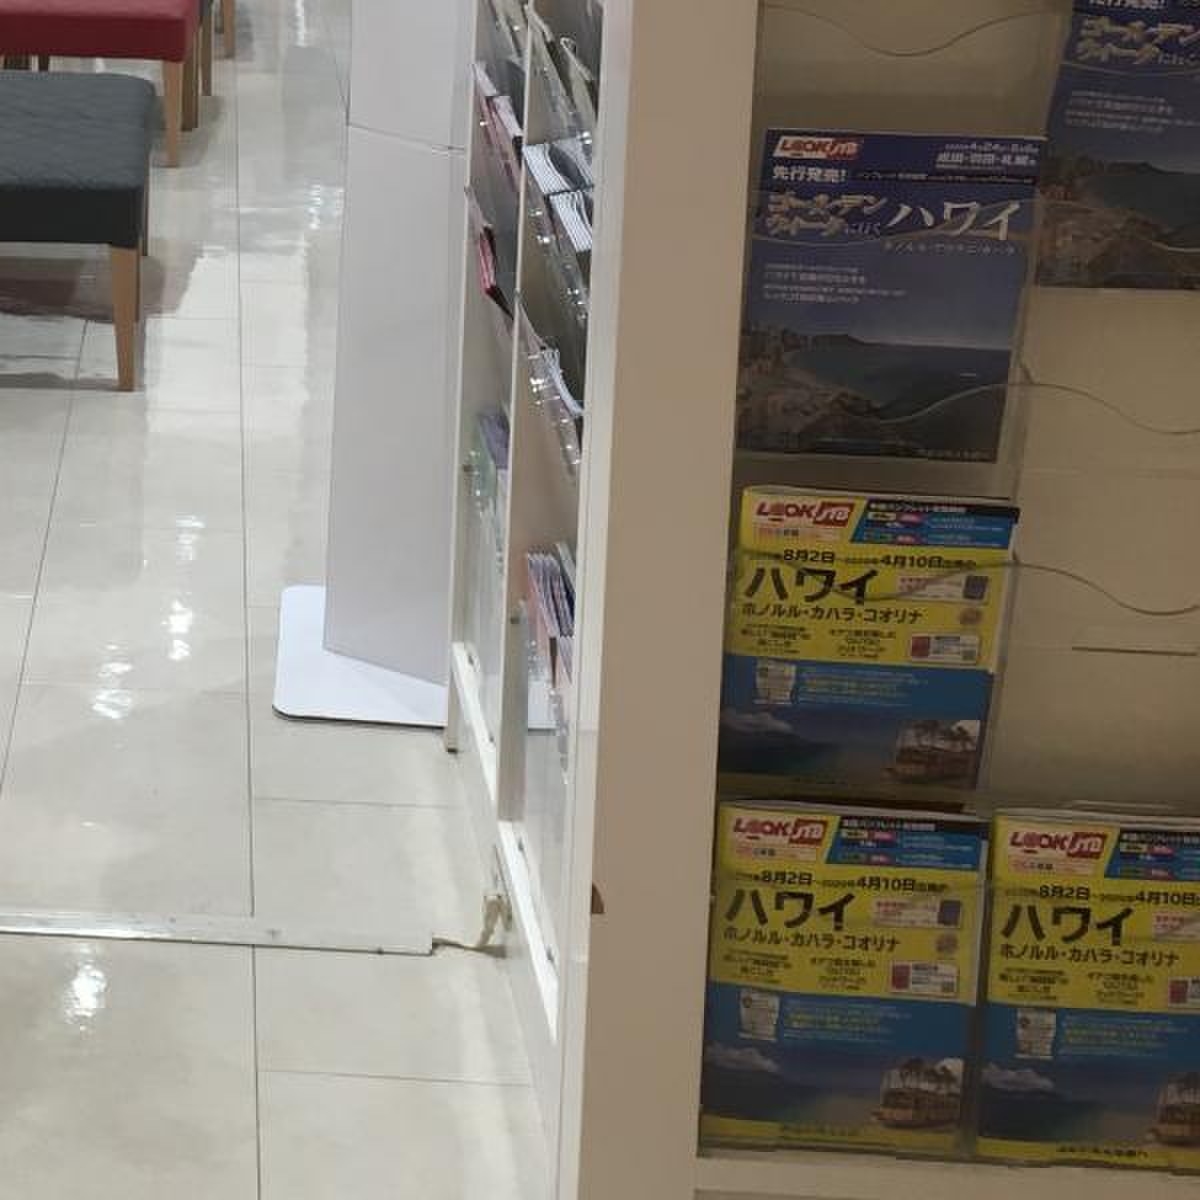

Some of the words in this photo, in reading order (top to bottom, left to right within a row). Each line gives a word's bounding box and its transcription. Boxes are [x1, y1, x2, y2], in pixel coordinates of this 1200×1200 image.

[887, 200, 1021, 241] ハワイ
[746, 567, 879, 605] ハワイ
[724, 888, 855, 931] ハワイ
[1002, 904, 1133, 946] ハワイ
